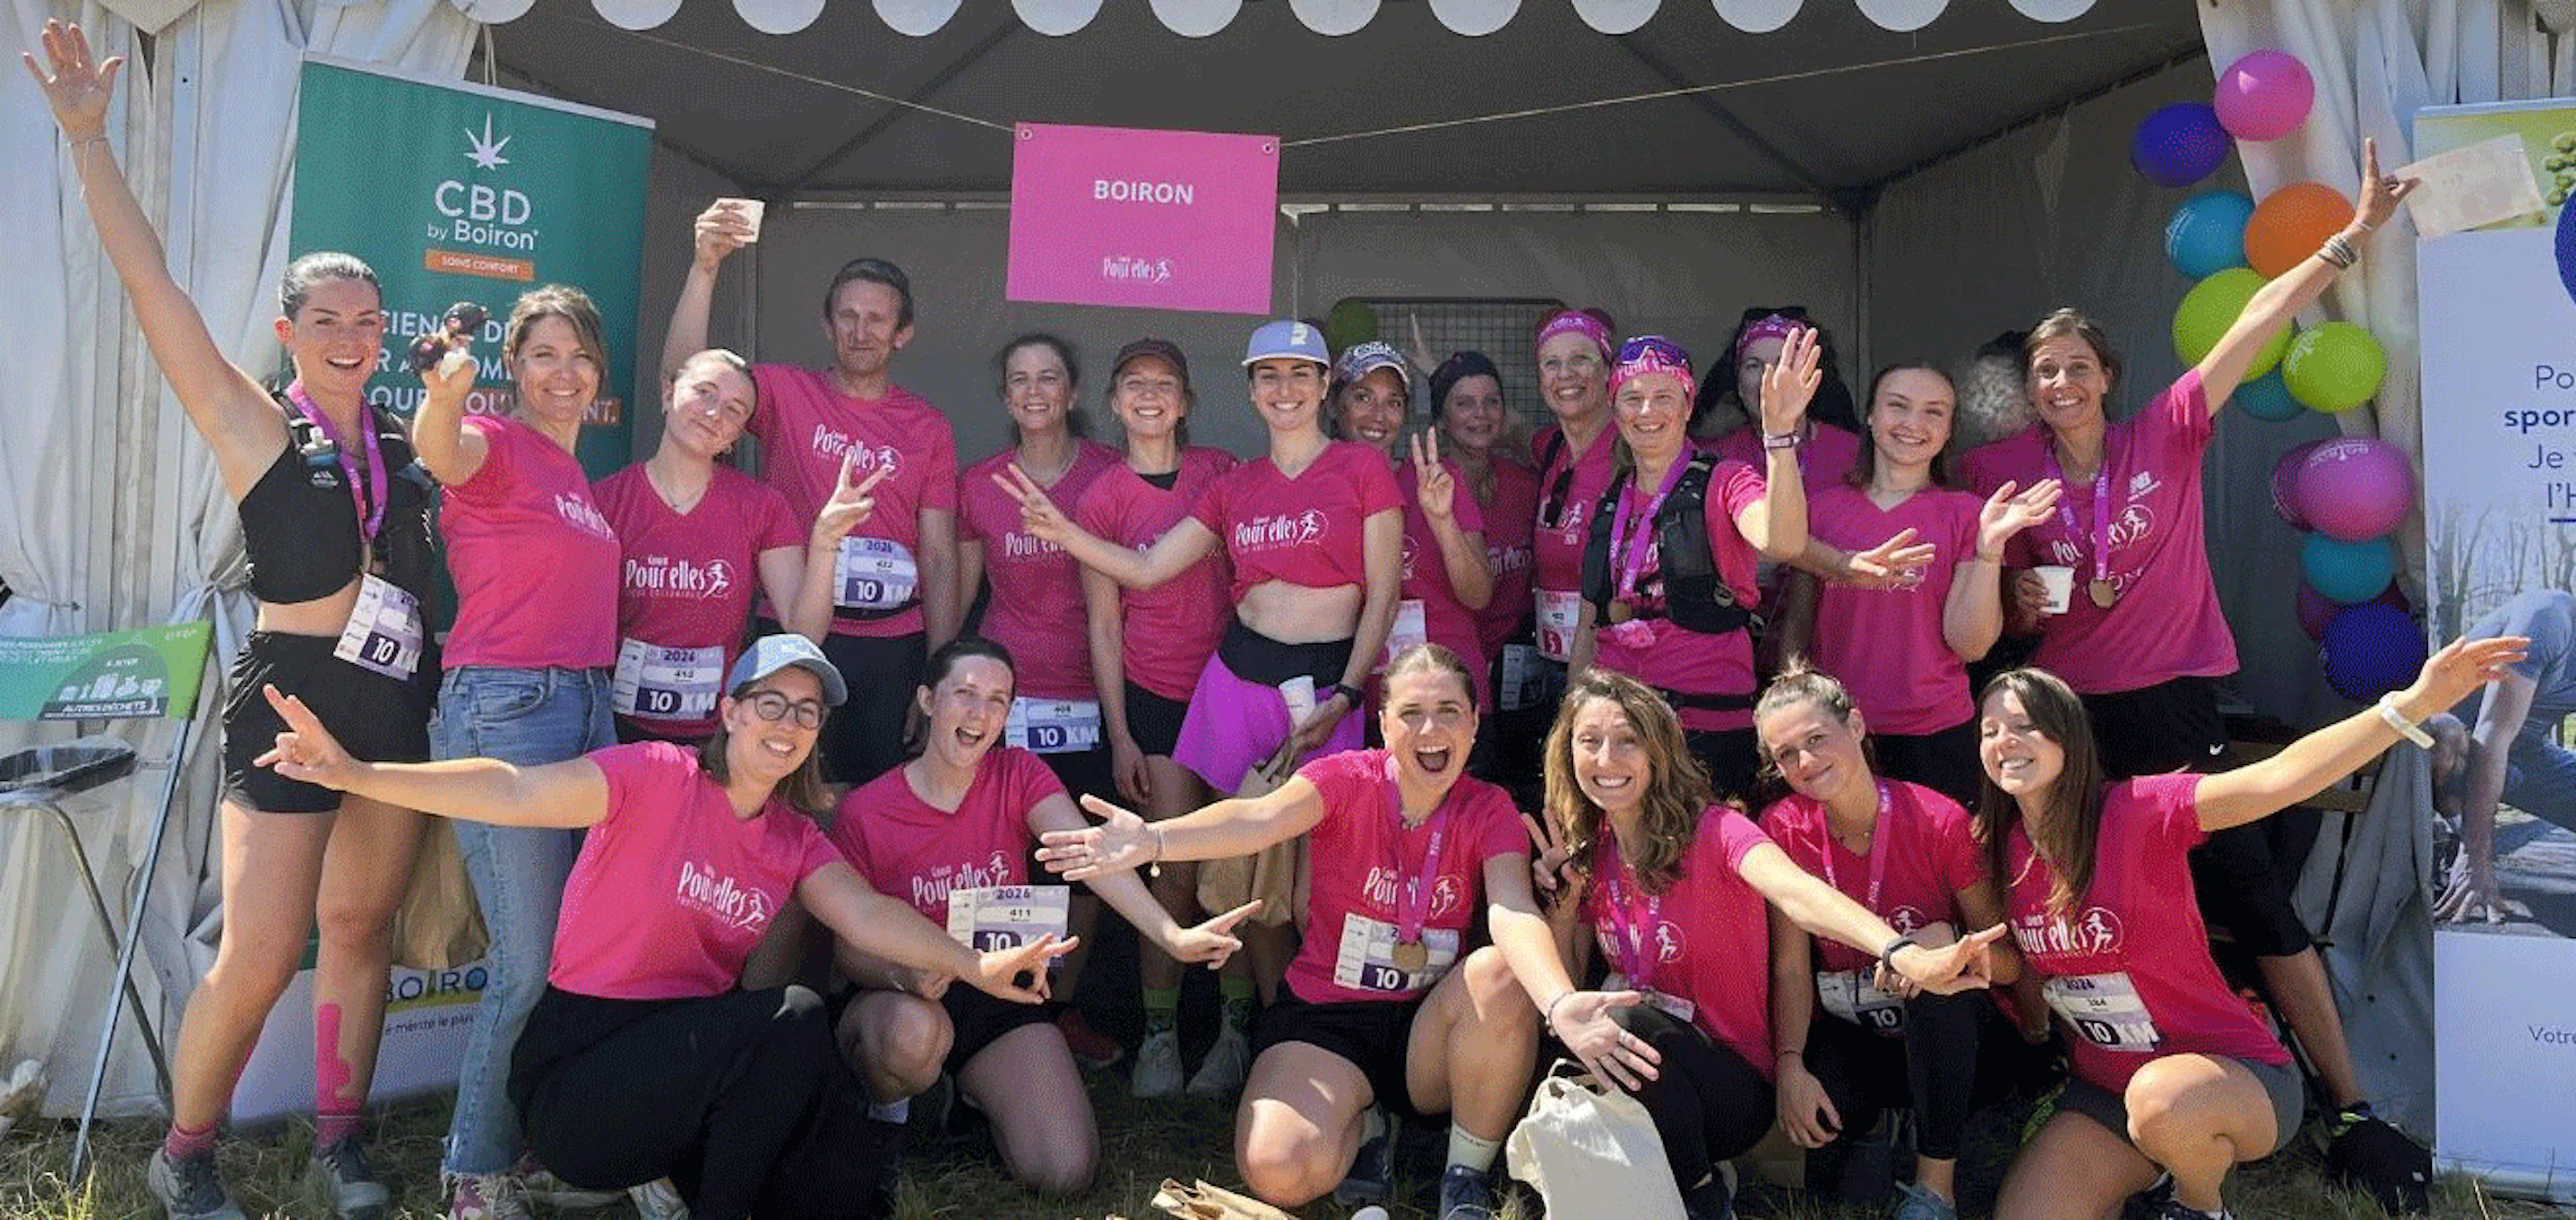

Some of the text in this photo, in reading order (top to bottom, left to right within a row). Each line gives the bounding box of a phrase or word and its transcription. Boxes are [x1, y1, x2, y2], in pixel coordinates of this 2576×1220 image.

[435, 180, 531, 225] CBD
[1093, 180, 1194, 205] BOIRON
[427, 223, 448, 240] by
[2528, 444, 2563, 469] Je
[625, 558, 705, 590] Pour elles
[857, 580, 877, 601] 10
[372, 638, 394, 662] 10
[649, 690, 674, 712] 10
[1038, 728, 1058, 746] 10
[912, 875, 953, 906] Pour
[954, 862, 992, 889] elles
[996, 888, 1031, 899] 2026
[985, 932, 1012, 953] 10
[1377, 967, 1400, 990] 10
[1869, 1008, 1897, 1028] 10
[2084, 1020, 2112, 1043] 10
